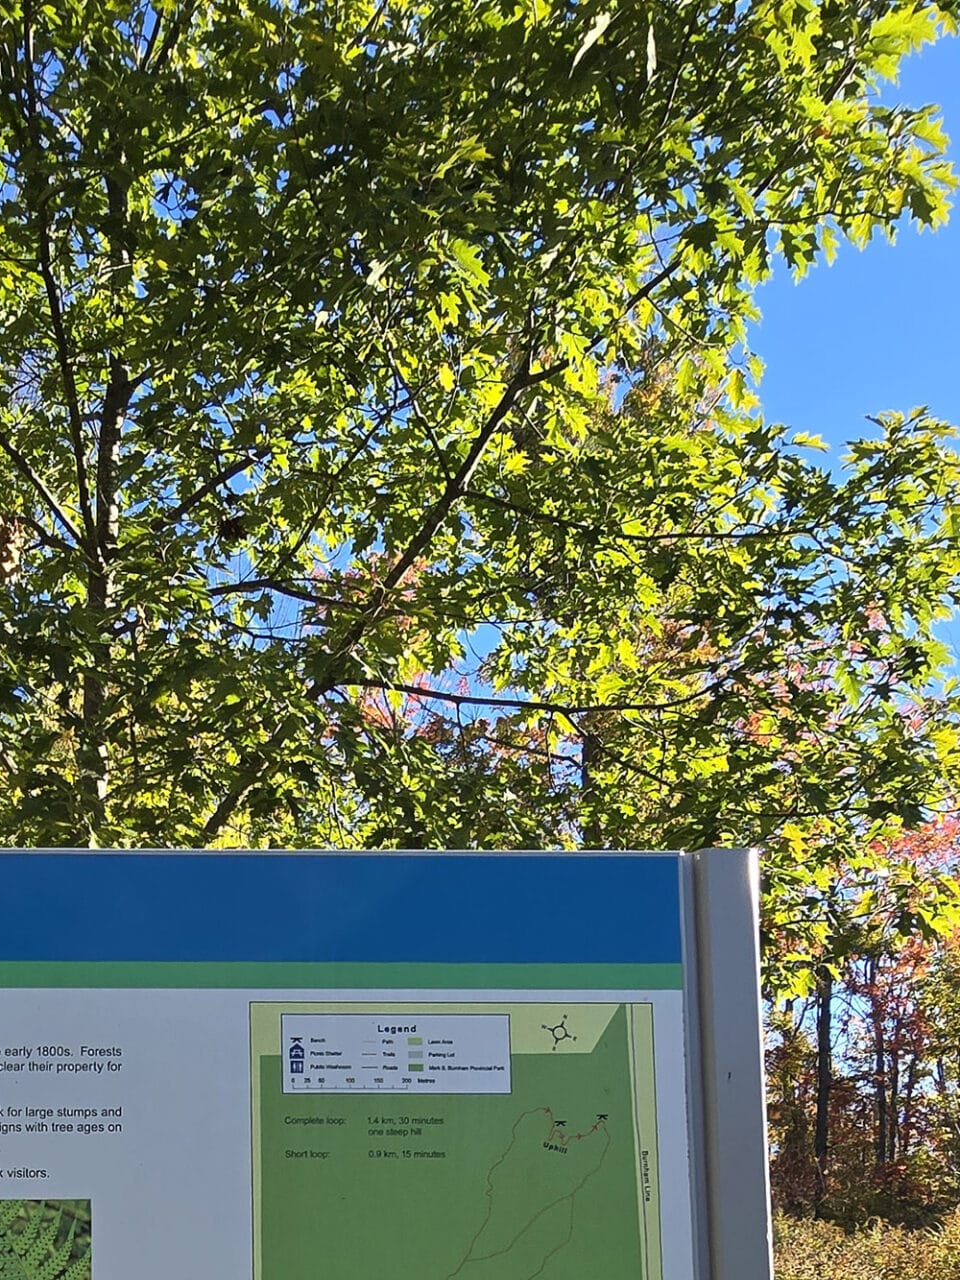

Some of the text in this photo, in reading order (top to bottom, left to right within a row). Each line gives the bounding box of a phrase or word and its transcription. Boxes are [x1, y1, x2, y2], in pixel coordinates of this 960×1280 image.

[377, 1025, 417, 1034] Legend
[4, 1046, 32, 1059] early
[37, 1046, 73, 1057] 1800s.
[80, 1046, 121, 1057] Forests
[543, 1141, 568, 1154] Uphill
[641, 1150, 649, 1184] Burnham
